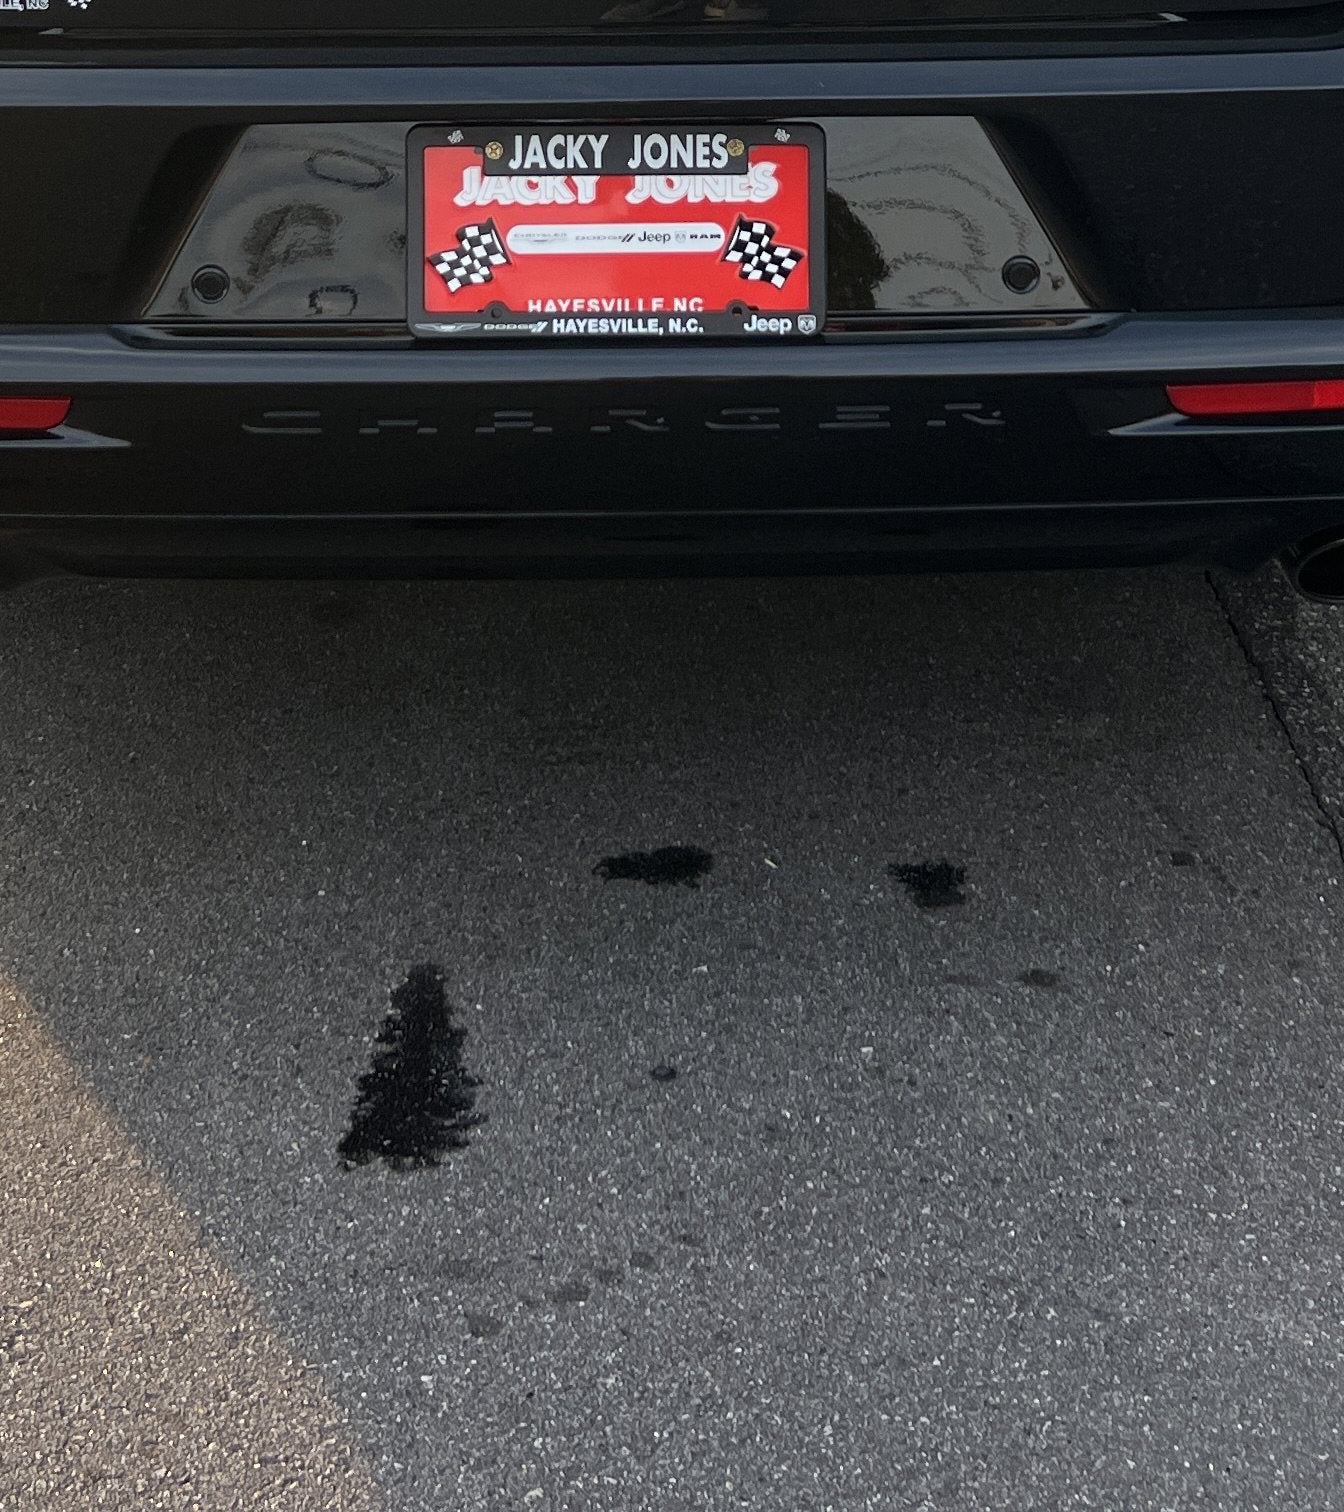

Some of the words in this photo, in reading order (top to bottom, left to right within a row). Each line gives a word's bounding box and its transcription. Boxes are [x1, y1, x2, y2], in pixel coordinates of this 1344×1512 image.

[508, 134, 609, 169] JACKY
[628, 133, 729, 169] JONES
[454, 166, 602, 206] JACKY
[625, 162, 781, 205] JONES
[638, 231, 671, 242] Jeep
[552, 318, 664, 336] HAYESVILLE,
[669, 317, 704, 334] N.C.
[743, 315, 793, 336] Jeep
[240, 402, 1008, 435] CHARGER
